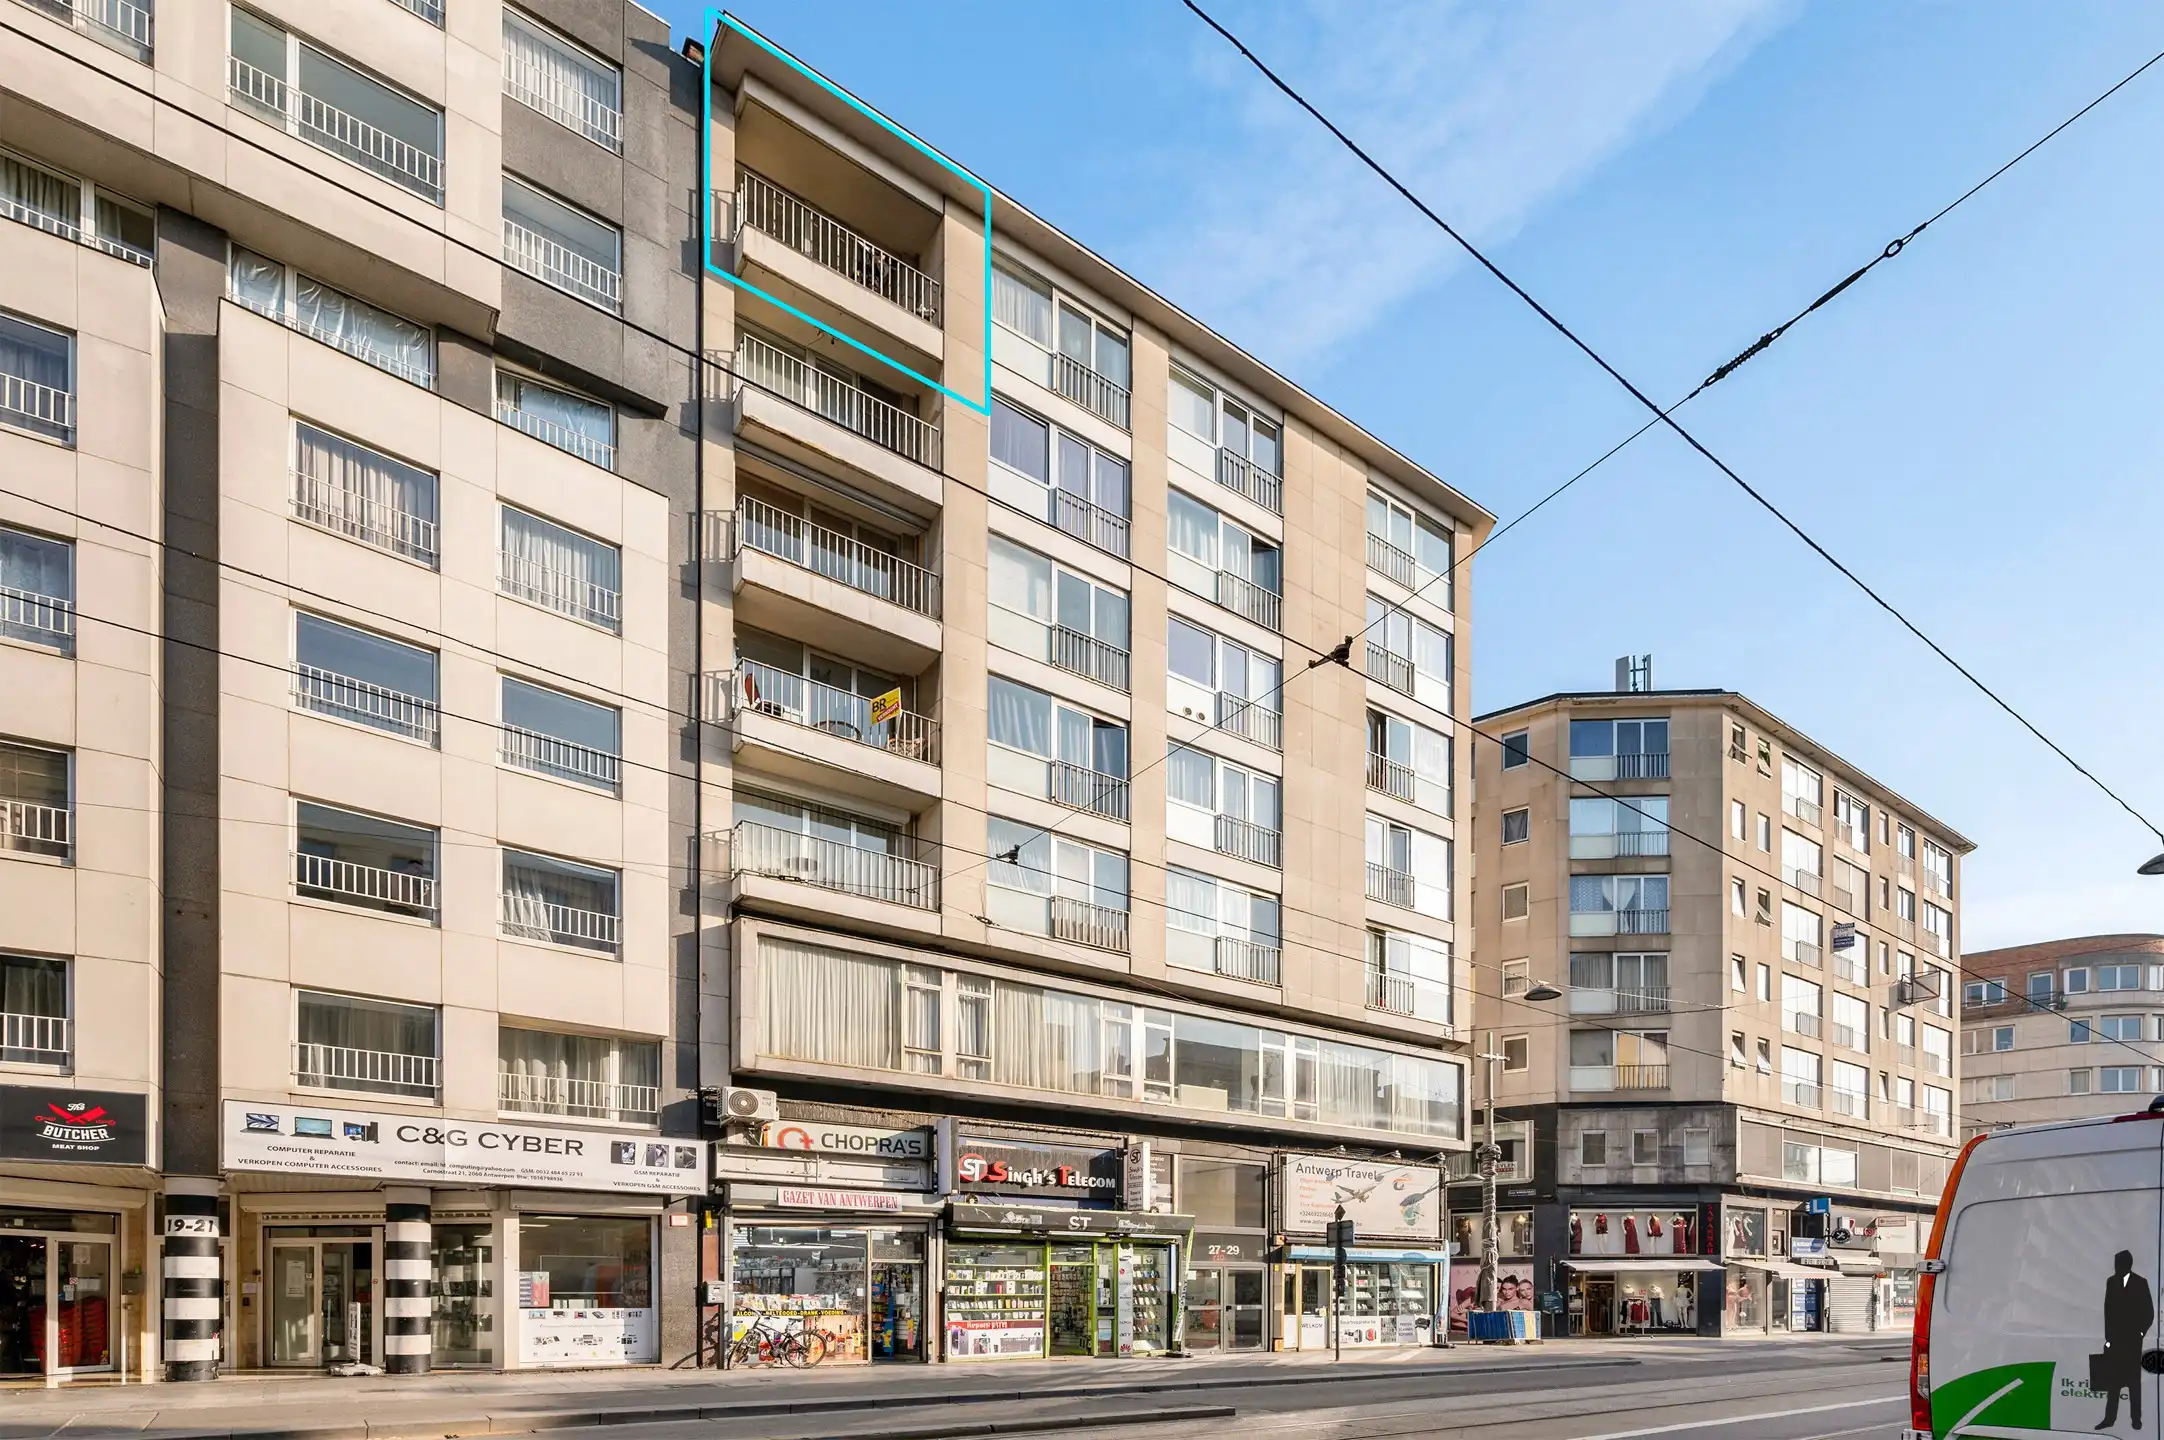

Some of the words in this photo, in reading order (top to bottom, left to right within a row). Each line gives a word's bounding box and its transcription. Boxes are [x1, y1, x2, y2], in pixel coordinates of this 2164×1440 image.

[872, 698, 886, 712] BR
[67, 1102, 86, 1112] The
[43, 1124, 109, 1140] BUTCHER
[396, 1125, 468, 1147] C&G
[478, 1132, 584, 1156] CYBER
[821, 1133, 921, 1155] CHOPRA'S
[267, 1146, 313, 1154] COMPUTER
[314, 1149, 356, 1157] REPARATIE
[238, 1158, 282, 1166] VERKOPEN
[284, 1162, 330, 1170] COMPUTER
[331, 1164, 382, 1172] ACCESSOIRES
[960, 1158, 987, 1181] ST
[1296, 1163, 1342, 1179] Antwerp
[1346, 1168, 1377, 1180] Travel
[783, 1190, 814, 1204] GAZET
[817, 1192, 836, 1205] VAN
[840, 1194, 898, 1209] ANTWERPEN
[167, 1219, 214, 1232] 19-21
[1068, 1216, 1092, 1230] ST
[1208, 1245, 1240, 1255] 27-29
[2061, 1378, 2074, 1387] Ik
